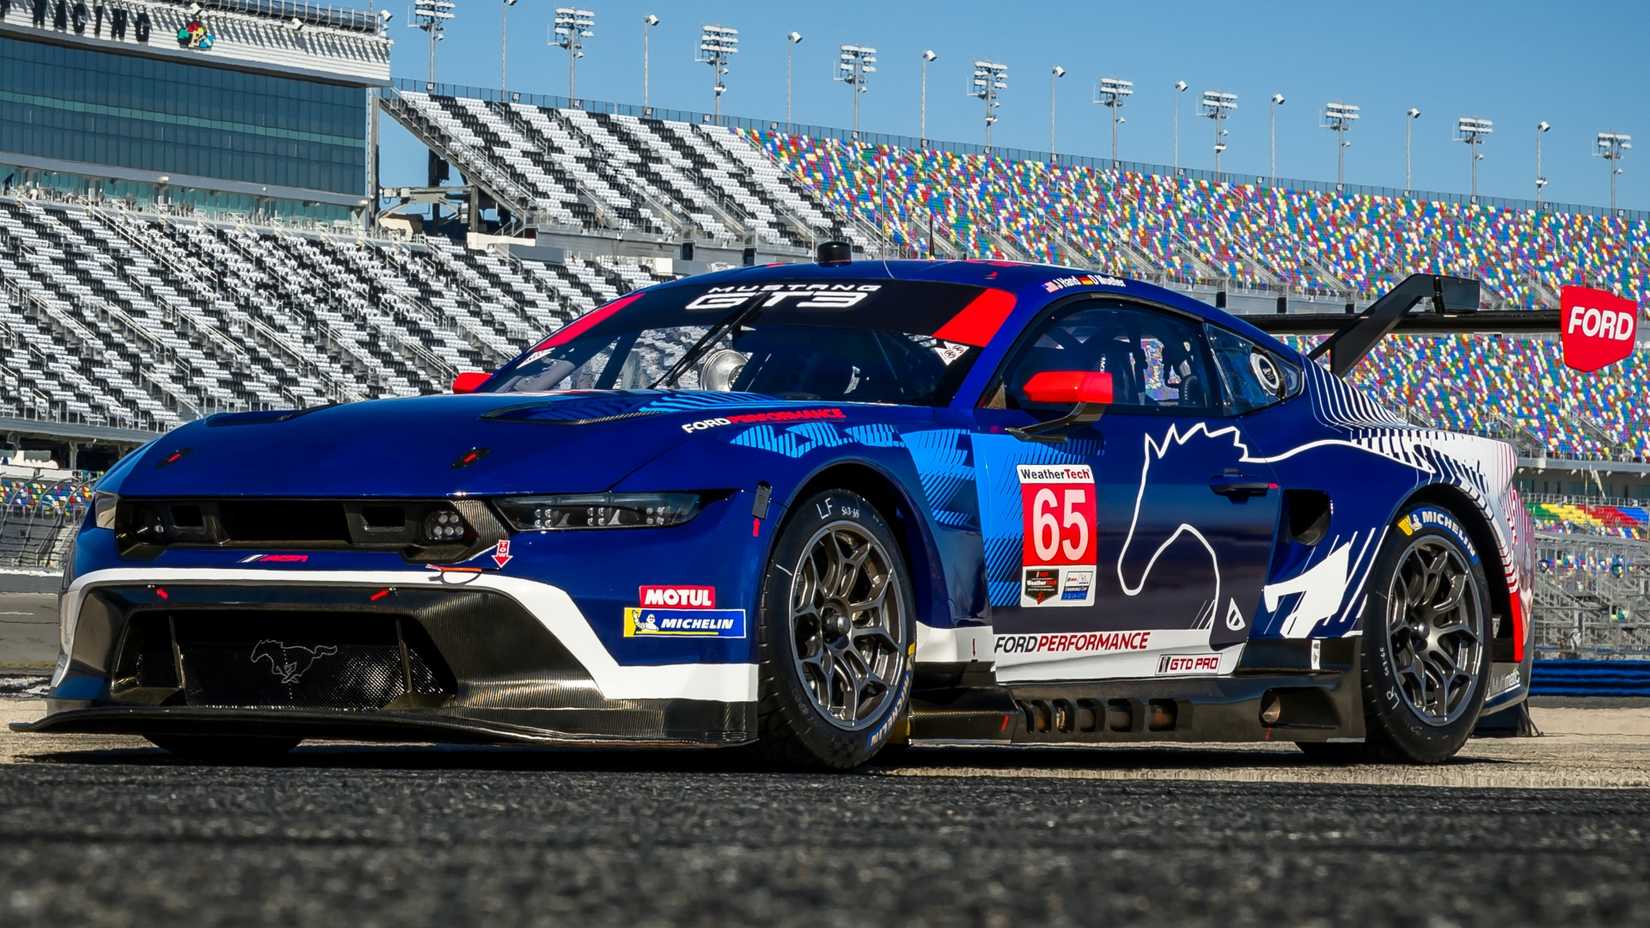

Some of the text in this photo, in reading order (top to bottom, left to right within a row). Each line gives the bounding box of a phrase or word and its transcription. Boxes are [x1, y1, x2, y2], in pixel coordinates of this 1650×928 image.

[32, 0, 151, 43] RACING
[708, 284, 882, 294] MUSTANG
[685, 290, 868, 310] GT3
[1567, 305, 1635, 341] FORD
[1020, 468, 1091, 480] WeatherTech
[815, 497, 833, 521] LF
[1032, 487, 1089, 562] 65
[1421, 510, 1476, 557] MICHELIN
[644, 588, 712, 607] MOTUL
[660, 618, 734, 630] MICHELIN
[1169, 656, 1219, 671] GTD PRO
